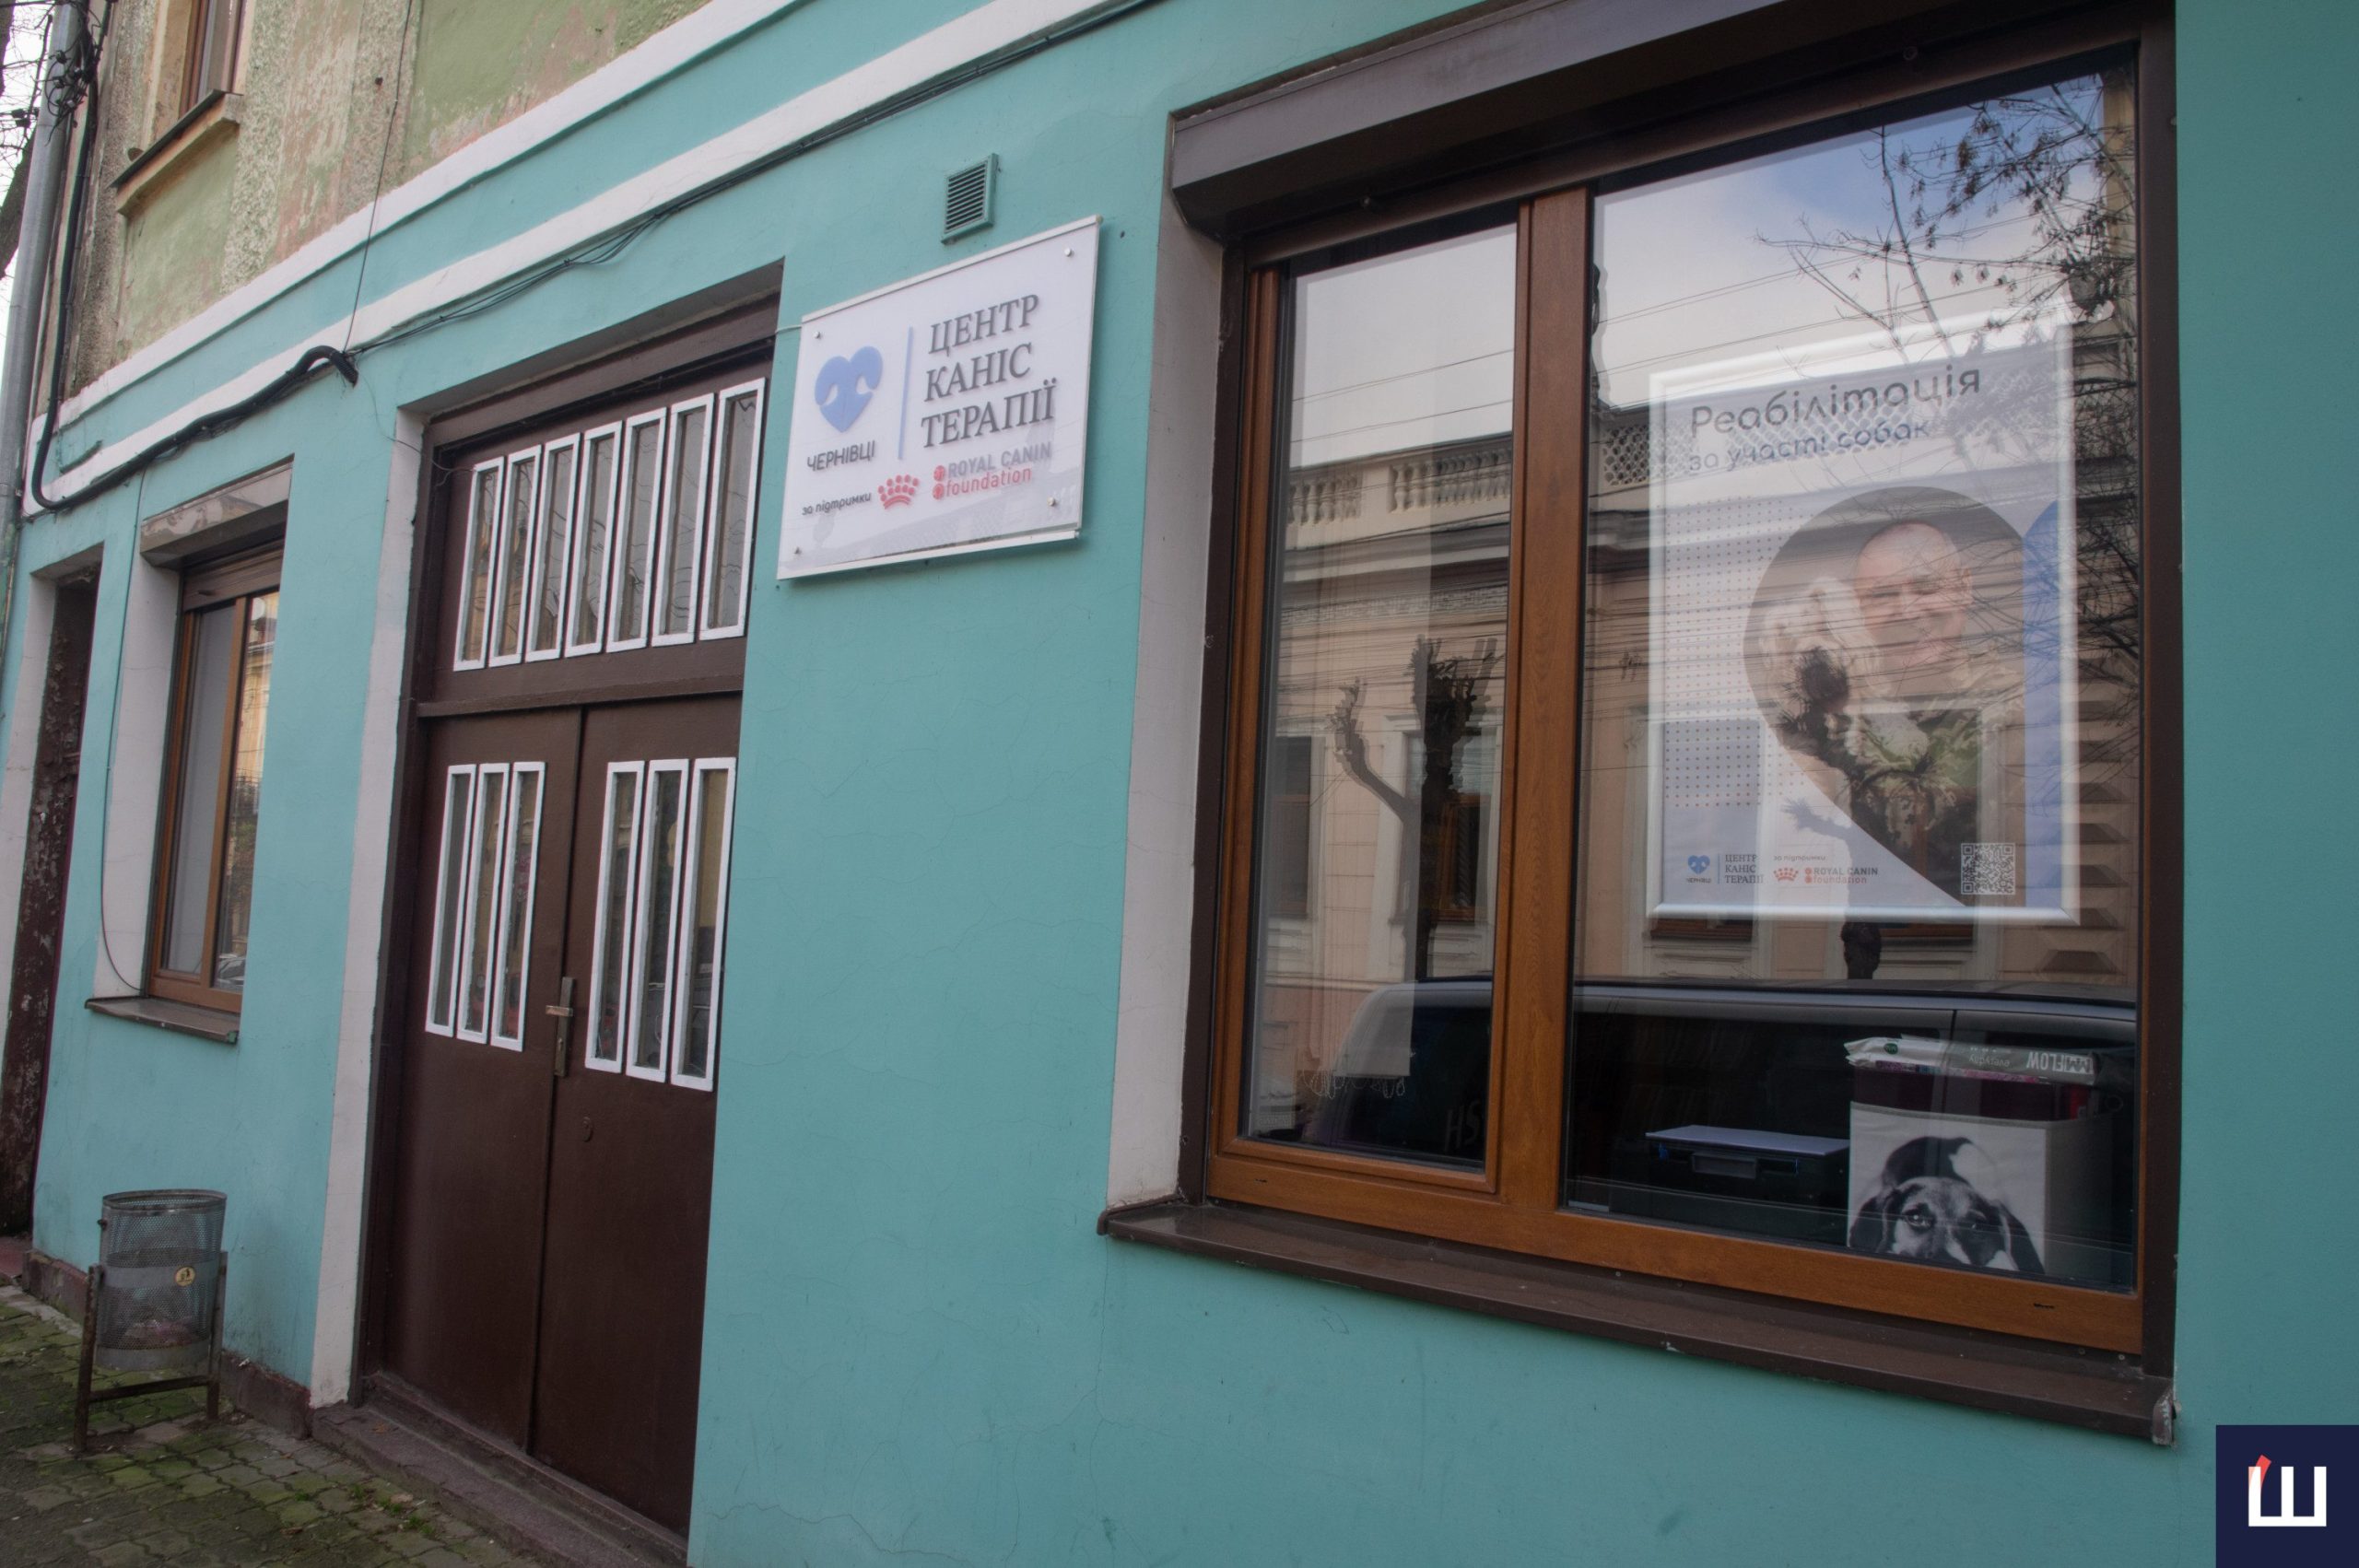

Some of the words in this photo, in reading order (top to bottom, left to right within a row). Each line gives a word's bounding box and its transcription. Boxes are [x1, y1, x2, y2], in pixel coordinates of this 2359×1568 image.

[928, 294, 1039, 357] ЦЕНТР
[923, 342, 1034, 403] КАНІС
[921, 377, 1058, 449] ТЕРАПІЇ
[1690, 366, 1981, 438] Реабілітація
[806, 440, 875, 472] ЧЕРНІВЦІ
[948, 454, 997, 478] ROYAL
[1001, 441, 1052, 468] CANIN
[1689, 452, 1719, 472] за
[1726, 429, 1827, 473] участі
[1837, 420, 1931, 450] собак
[945, 466, 1033, 497] foundation
[802, 505, 814, 516] за
[815, 492, 873, 513] підтримки
[1725, 853, 1758, 864] ЦЕНТР
[1725, 864, 1757, 874] КАНІС
[1813, 867, 1844, 876] ROYAL
[1847, 867, 1879, 876] CANIN
[1813, 875, 1868, 884] foundation
